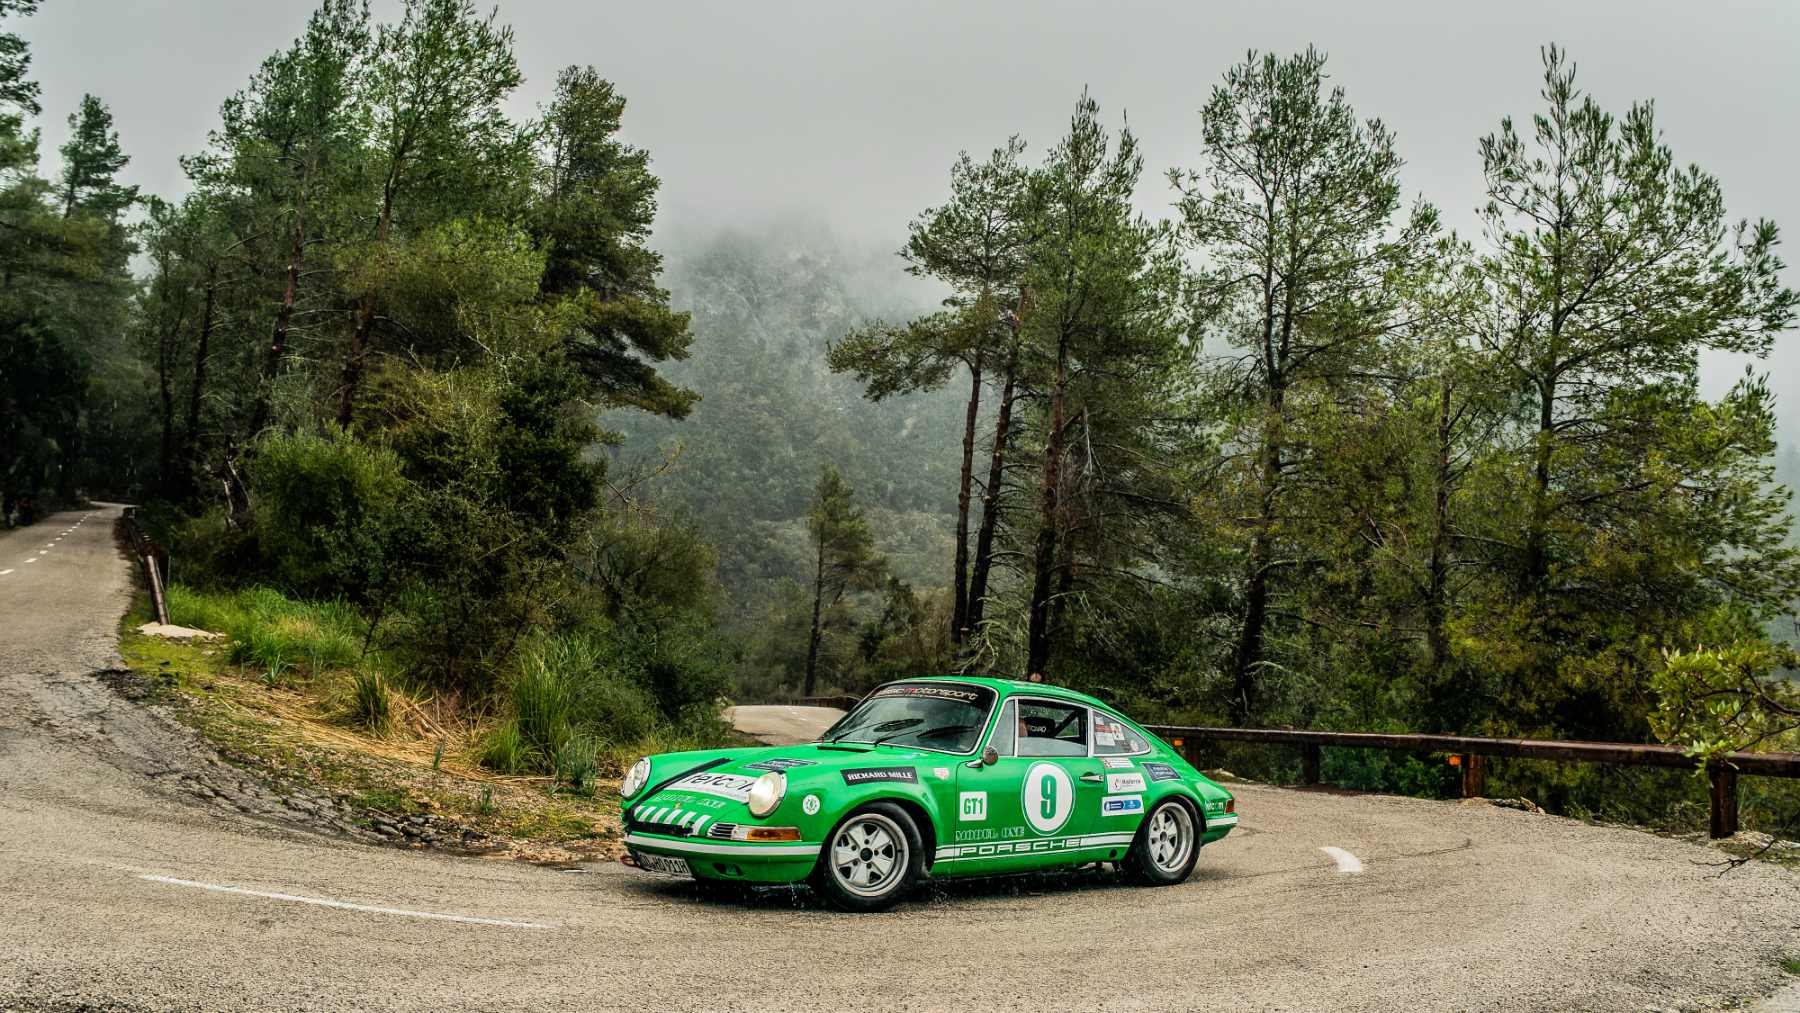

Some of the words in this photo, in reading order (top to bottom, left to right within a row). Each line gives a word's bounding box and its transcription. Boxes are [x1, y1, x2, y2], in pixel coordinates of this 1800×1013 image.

[847, 771, 887, 781] RICHARD
[888, 770, 913, 780] MILLE
[963, 797, 984, 816] GT1
[1040, 774, 1057, 820] 9
[960, 838, 1082, 857] PORSCHE
